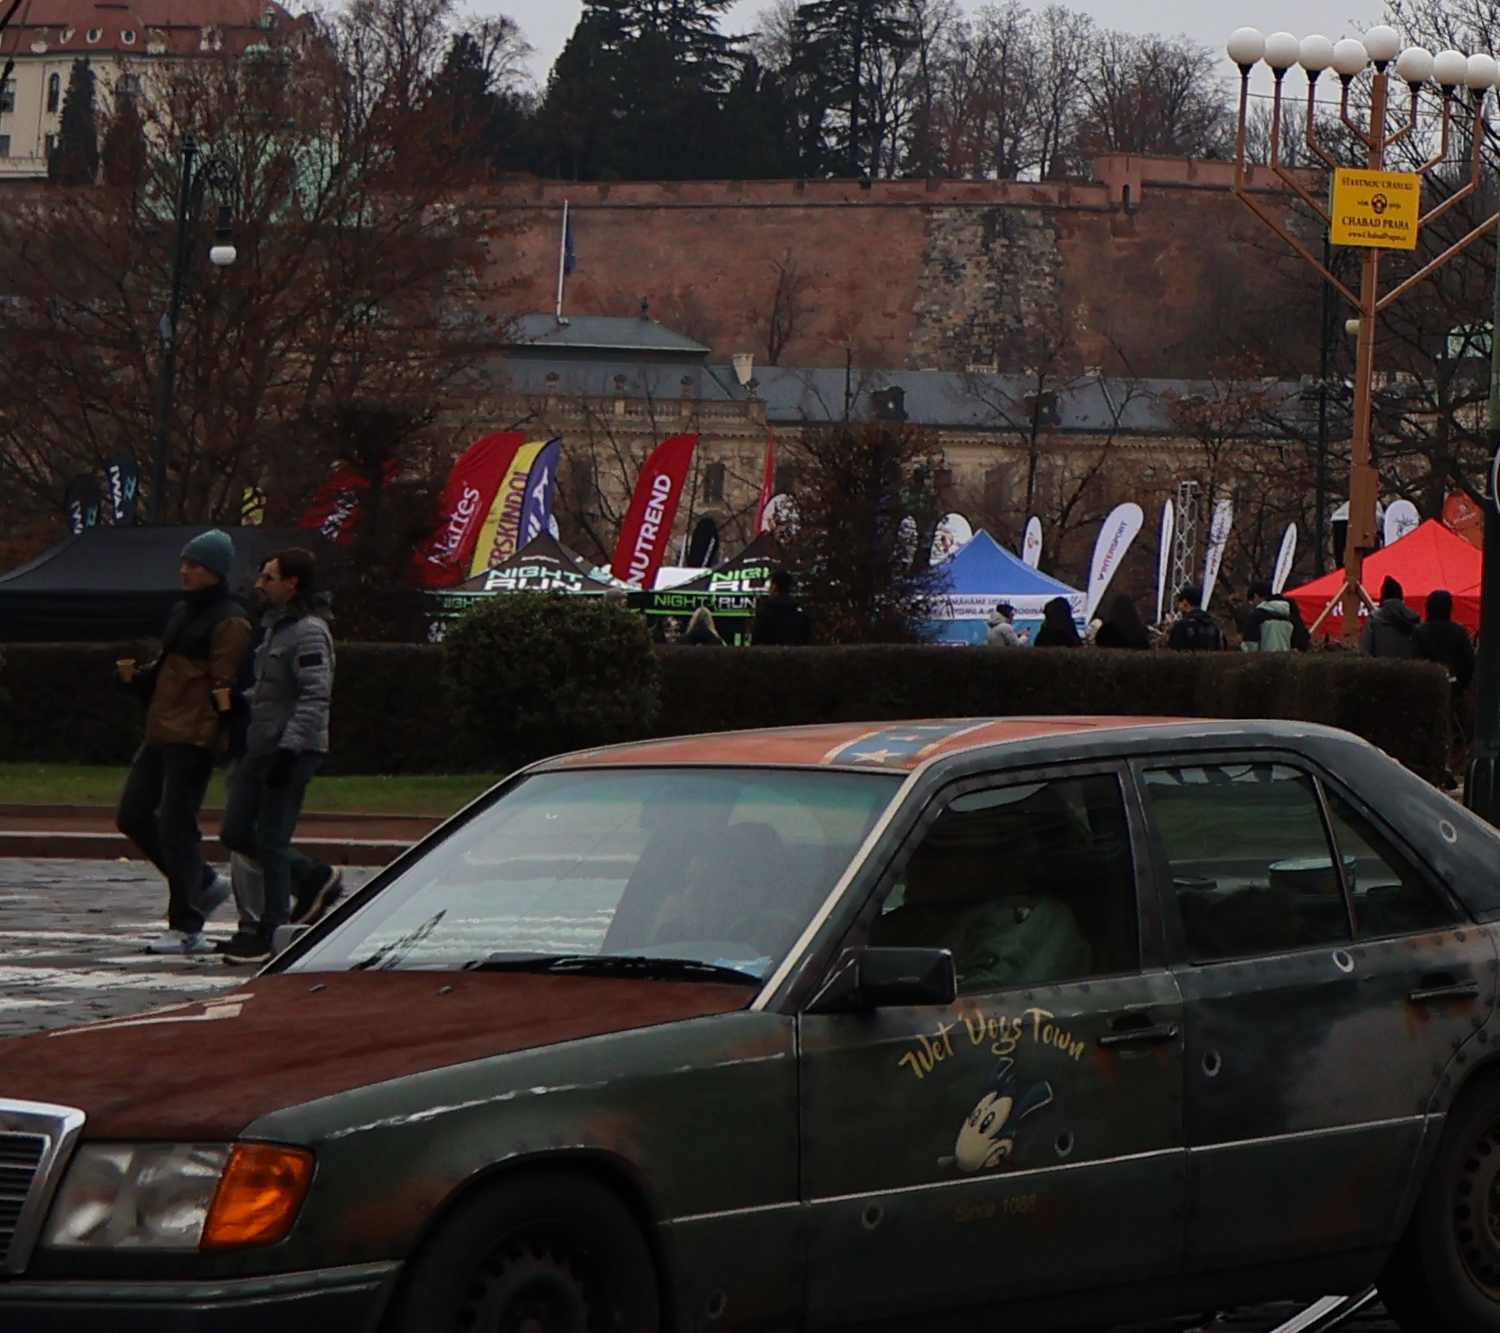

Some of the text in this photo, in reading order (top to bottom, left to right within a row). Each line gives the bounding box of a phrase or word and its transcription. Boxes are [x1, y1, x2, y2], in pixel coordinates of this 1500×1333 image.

[625, 473, 672, 588] NUTREND
[487, 565, 584, 582] NIGHT
[484, 577, 582, 591] RUN
[653, 594, 757, 609] NIGHT RUN
[1023, 1007, 1086, 1061] Town
